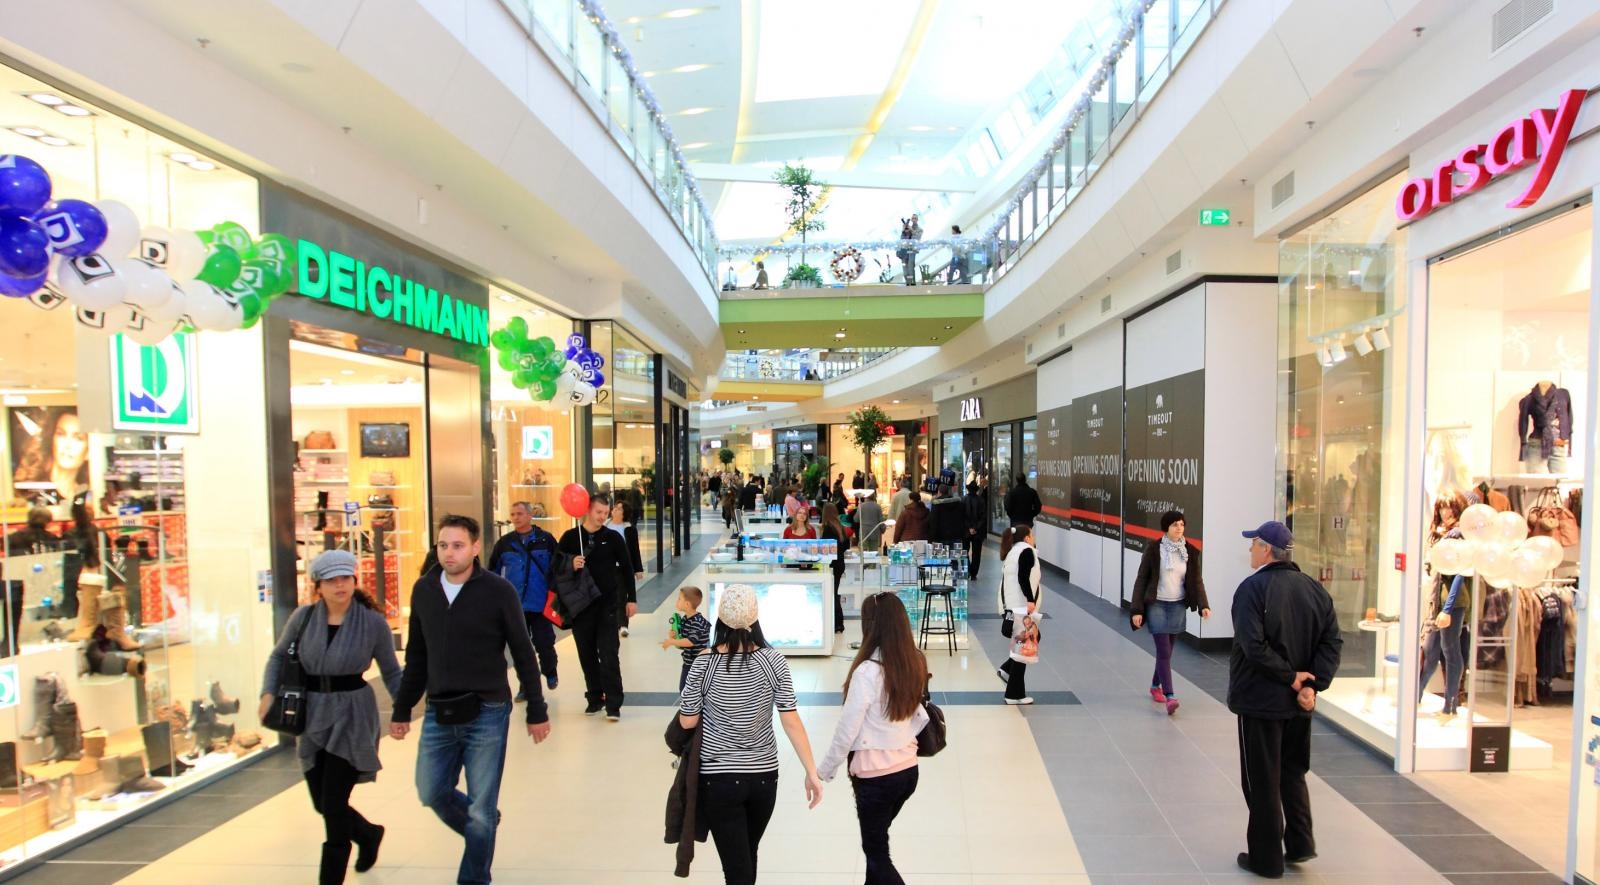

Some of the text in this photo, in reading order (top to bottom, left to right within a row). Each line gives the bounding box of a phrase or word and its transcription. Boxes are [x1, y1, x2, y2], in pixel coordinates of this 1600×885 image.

[1395, 89, 1588, 220] orsay
[141, 240, 167, 263] D
[297, 239, 489, 348] DEICHMANN
[960, 398, 981, 421] ZARA
[1148, 411, 1173, 425] TIMEOUT
[1038, 459, 1072, 477] OPENING SOON
[1073, 454, 1120, 476] OPENING SOON
[1128, 457, 1199, 486] OPENING SOON
